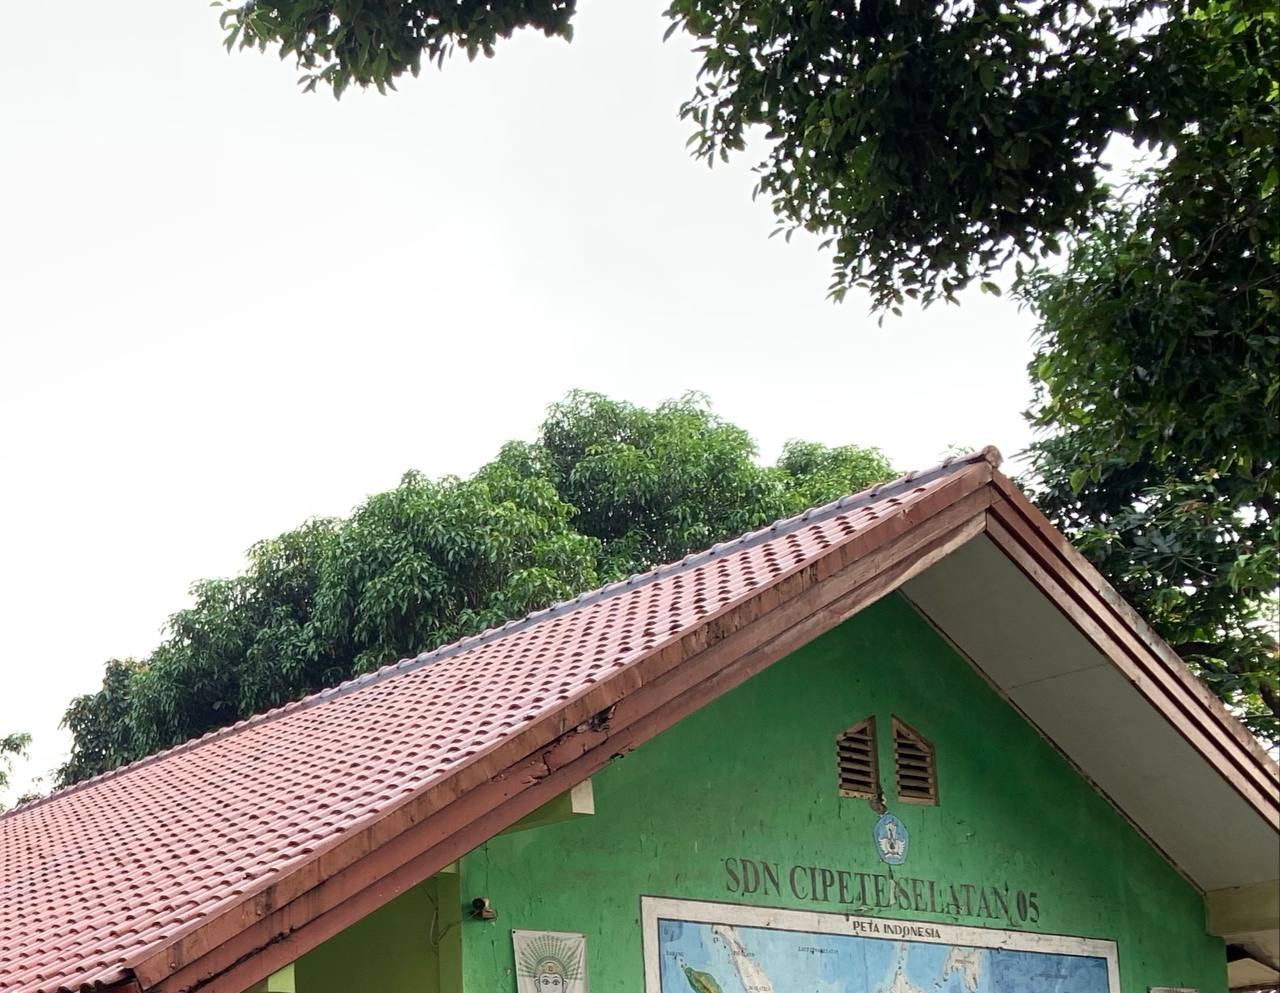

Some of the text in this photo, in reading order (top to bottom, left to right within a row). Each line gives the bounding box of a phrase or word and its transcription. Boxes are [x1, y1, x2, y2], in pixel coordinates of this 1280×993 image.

[724, 857, 1040, 923] SDN CIPETE SELATAN 05
[852, 920, 941, 938] PETA INDONESIA
